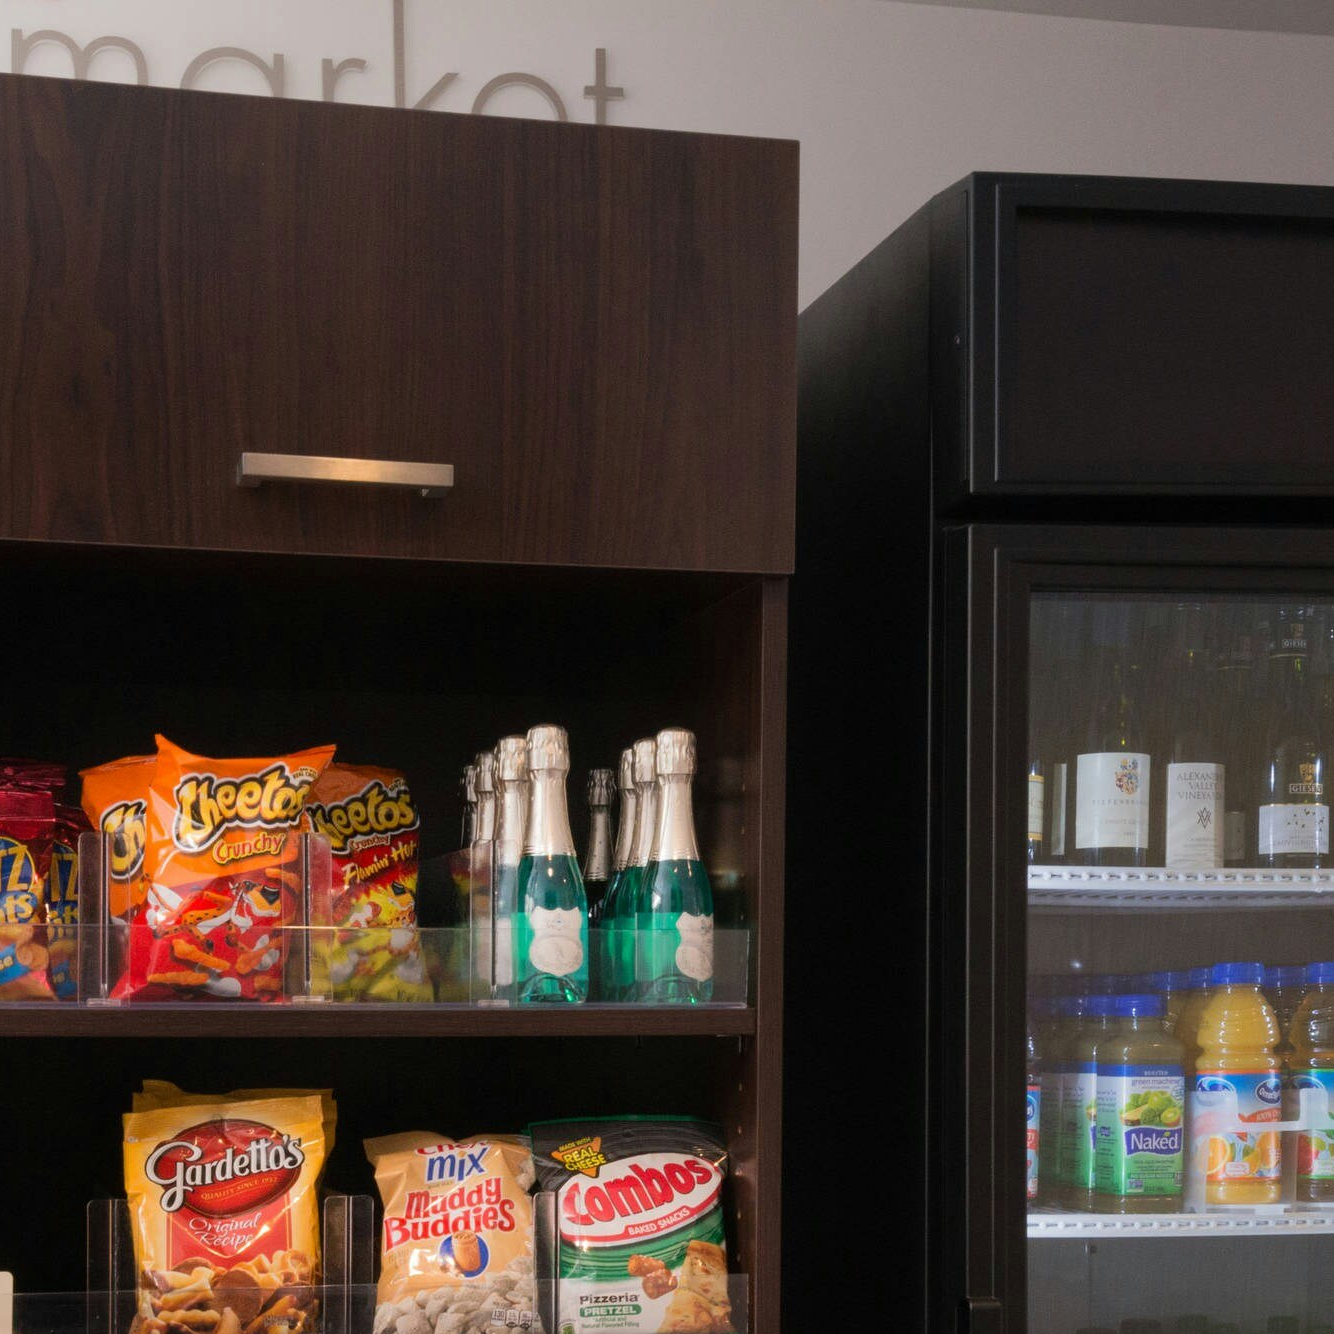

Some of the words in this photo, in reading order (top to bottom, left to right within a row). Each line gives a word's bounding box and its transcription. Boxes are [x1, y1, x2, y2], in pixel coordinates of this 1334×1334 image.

[1291, 784, 1322, 794] GIESEN
[177, 766, 307, 836] Cheetos
[214, 832, 286, 863] Crunchy
[1130, 1133, 1180, 1151] Naked
[563, 1145, 589, 1163] REAL
[565, 1153, 606, 1171] CHEESE
[145, 1135, 306, 1213] Gardetto's
[562, 1158, 713, 1225] Combos
[188, 1214, 261, 1237] Original
[384, 1199, 516, 1253] Buddies
[628, 1220, 657, 1236] BAKED
[658, 1208, 690, 1230] SNACKS
[193, 1228, 254, 1248] Recipe
[579, 1293, 638, 1306] Pizzeria
[583, 1304, 638, 1317] PRETZEL
